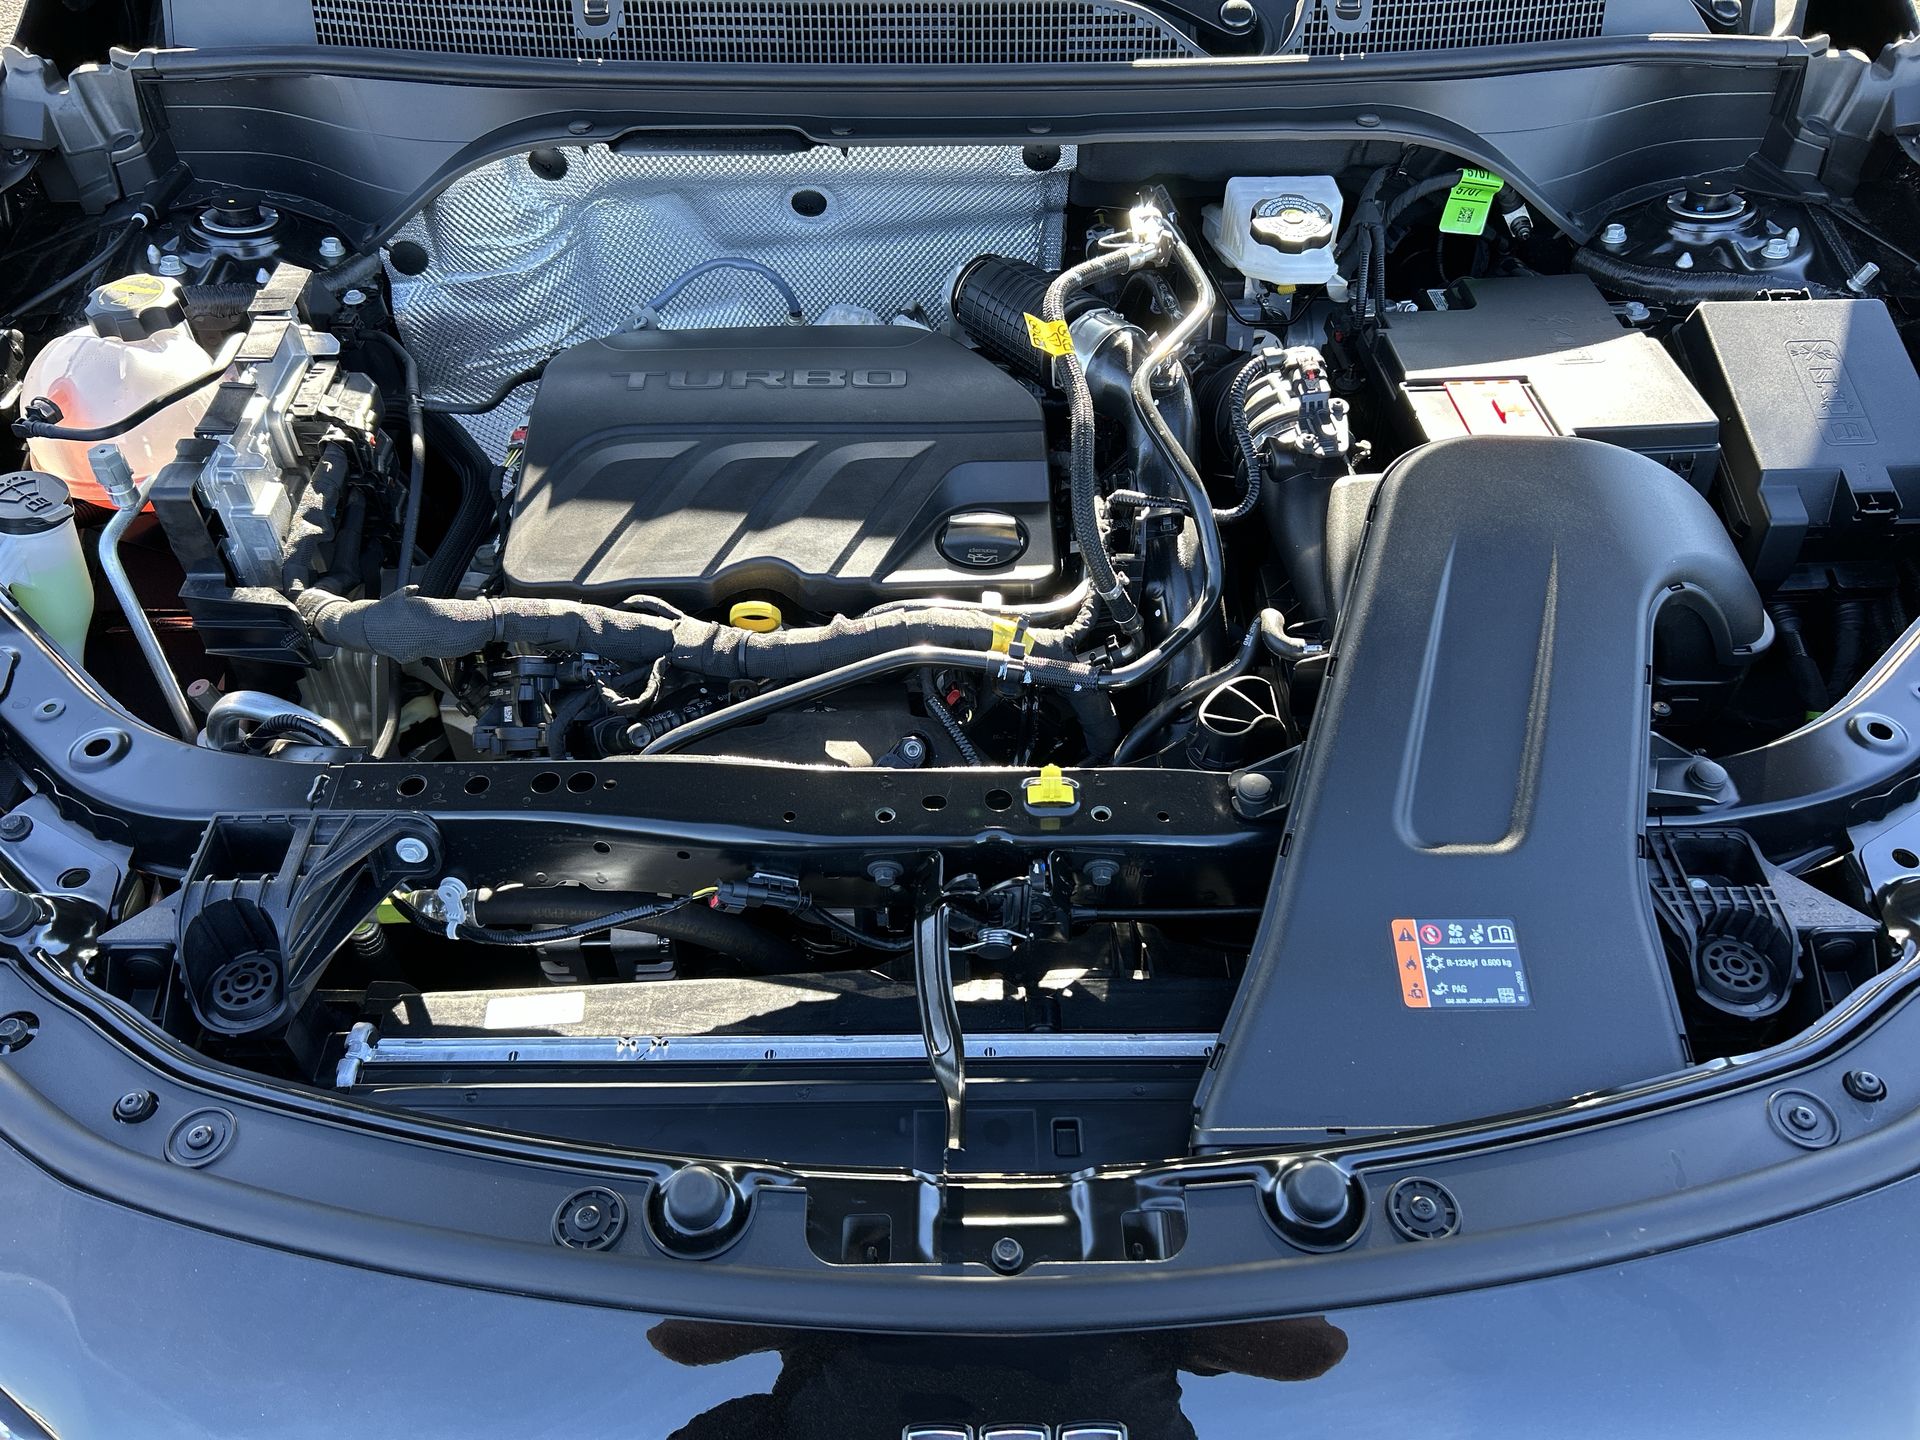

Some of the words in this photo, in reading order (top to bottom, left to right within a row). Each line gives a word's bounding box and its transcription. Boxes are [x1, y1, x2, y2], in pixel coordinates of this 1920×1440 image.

[1456, 187, 1481, 197] 5707
[609, 369, 908, 391] TURBO
[1446, 959, 1479, 968] R-1234yf
[1502, 959, 1512, 968] kg
[1451, 985, 1468, 993] PAG
